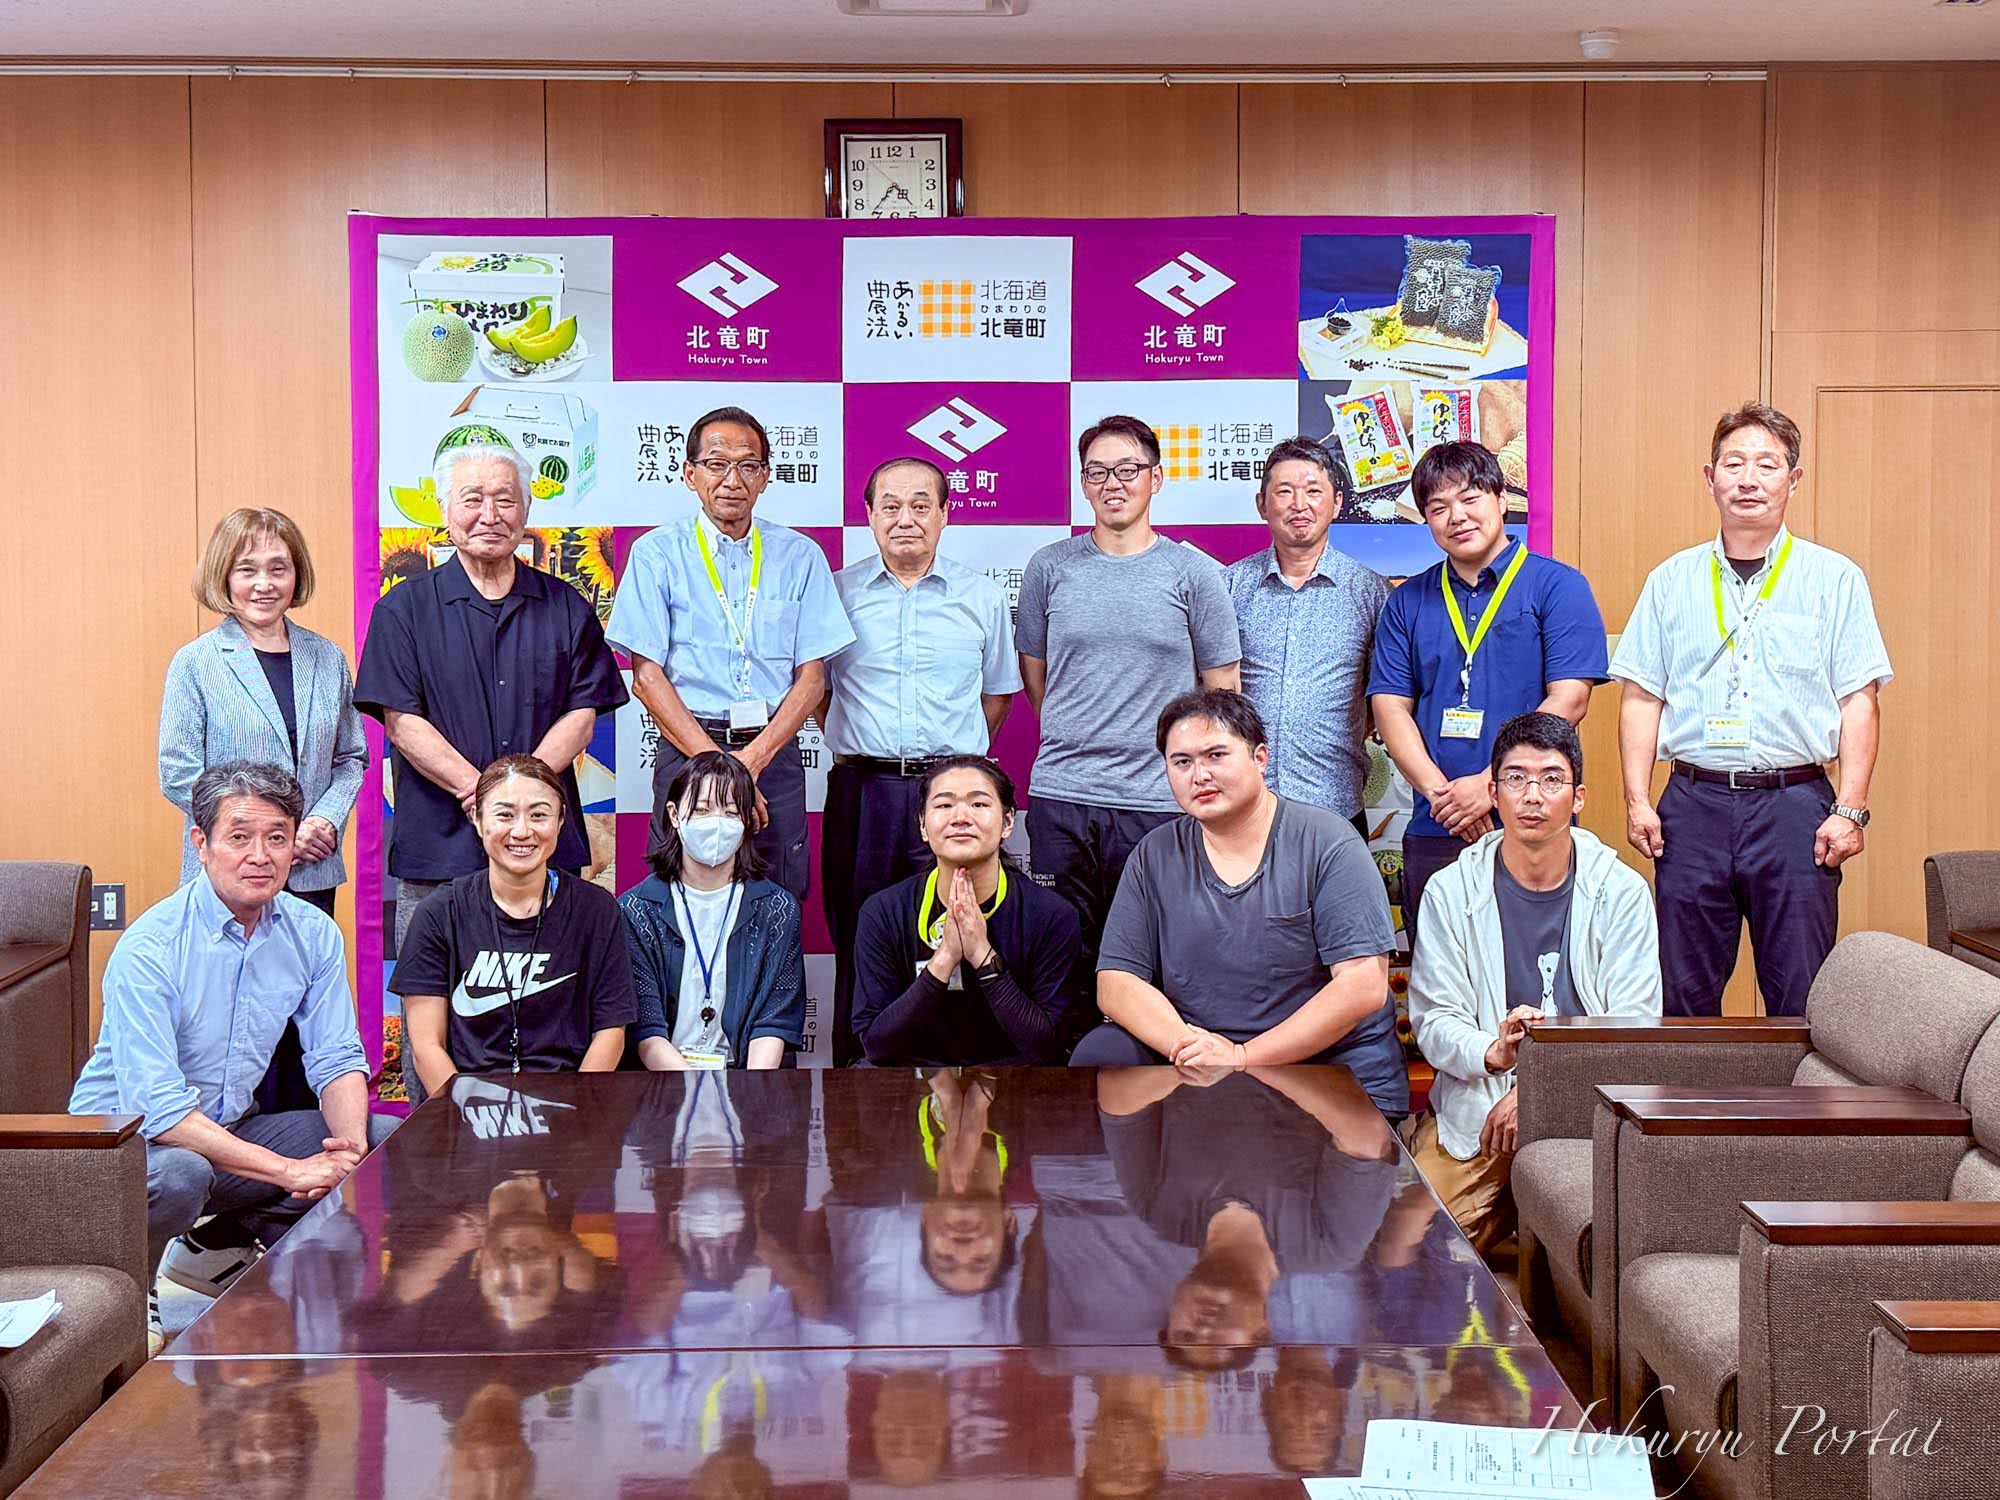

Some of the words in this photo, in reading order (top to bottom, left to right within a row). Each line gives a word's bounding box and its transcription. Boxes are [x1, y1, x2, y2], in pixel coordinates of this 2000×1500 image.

[870, 146, 882, 158] 11
[886, 145, 902, 158] 12
[909, 146, 916, 158] 1
[852, 160, 865, 172] 10
[924, 159, 936, 171] 2
[853, 179, 863, 191] 9
[925, 179, 936, 191] 3
[854, 199, 865, 211] 8
[924, 198, 935, 210] 4
[980, 280, 1047, 301] 北海道
[451, 300, 528, 321] ひまわり
[867, 280, 890, 338] 農法
[893, 281, 913, 339] あかるい
[980, 304, 1047, 314] ひまわりの
[980, 318, 1047, 338] 北竜町
[686, 325, 770, 349] 北竜町
[1143, 324, 1227, 348] 北竜町
[688, 353, 735, 367] Hokuryu
[739, 354, 768, 364] Town
[1145, 353, 1191, 366] Hokuryu
[1196, 352, 1224, 362] Town
[1208, 422, 1274, 444] 北海道
[637, 424, 660, 482] 農法
[664, 424, 684, 484] あかるい
[1208, 447, 1273, 457] ひまわりの
[969, 497, 997, 507] Town
[465, 951, 551, 988] NIKE
